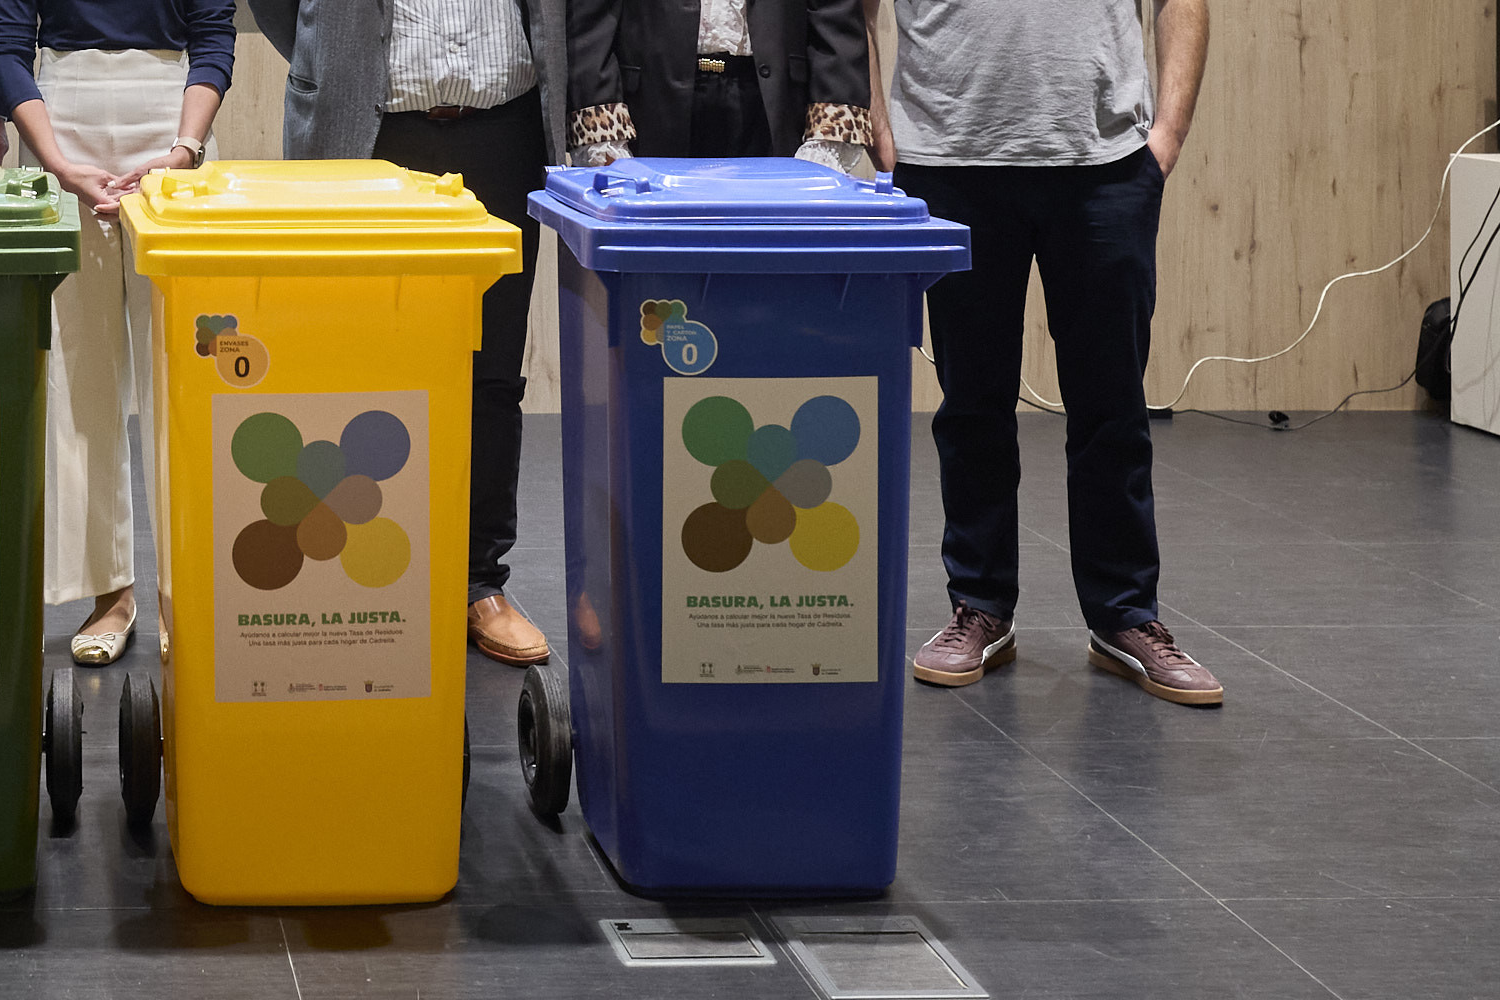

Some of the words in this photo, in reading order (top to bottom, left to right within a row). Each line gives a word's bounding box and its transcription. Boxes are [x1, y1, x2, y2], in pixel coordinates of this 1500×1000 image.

[682, 343, 698, 366] 0
[234, 356, 250, 378] 0
[686, 596, 764, 610] BASURA,
[770, 595, 792, 608] LA
[796, 595, 854, 608] JUSTA.
[238, 613, 316, 627] BASURA,
[321, 612, 343, 625] LA
[348, 611, 406, 624] JUSTA.
